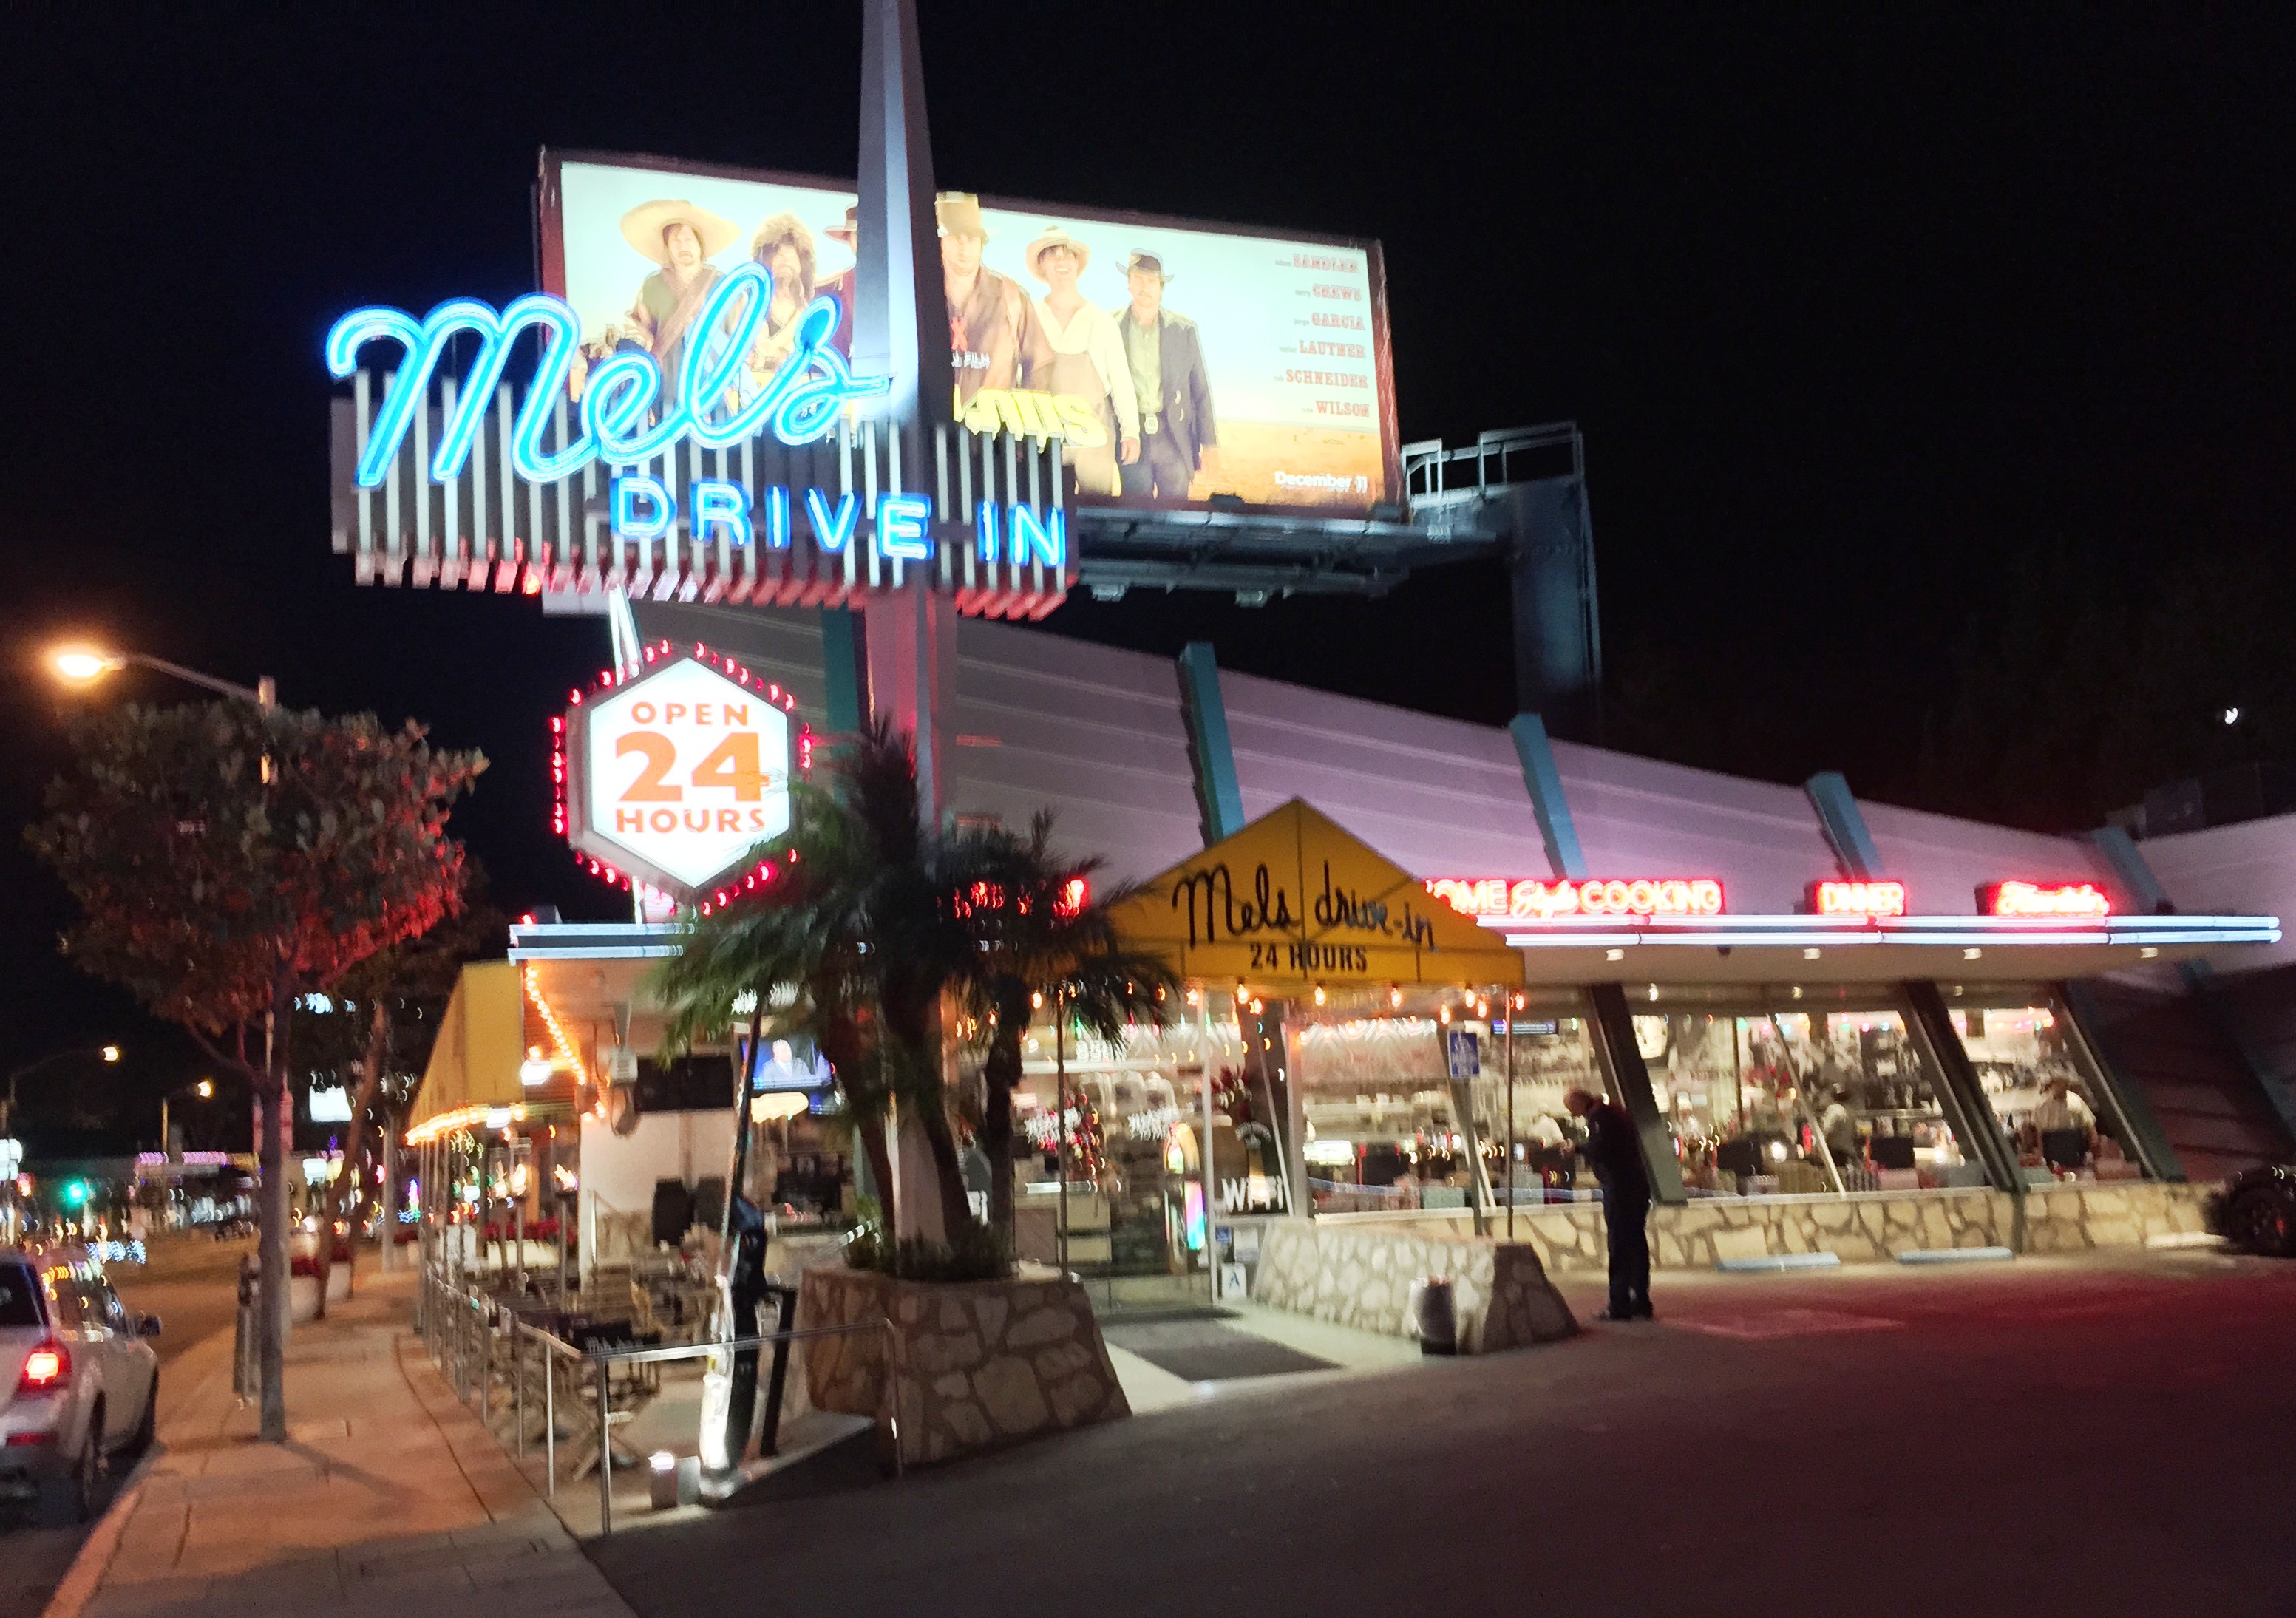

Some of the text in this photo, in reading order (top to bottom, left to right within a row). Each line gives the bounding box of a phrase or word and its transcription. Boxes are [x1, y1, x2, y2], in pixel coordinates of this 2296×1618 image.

[1292, 253, 1360, 274] SANDLER
[1312, 283, 1362, 302] CREWS
[1311, 312, 1365, 330] GARCIA
[1299, 339, 1367, 359] LAUTNER
[325, 260, 891, 488] Mels
[1286, 368, 1369, 389] SCHNEIDER
[1315, 400, 1370, 418] WILSON
[1274, 470, 1352, 492] December
[611, 475, 1069, 568] DRIVE IN
[631, 701, 750, 727] OPEN
[615, 730, 770, 803] 24
[615, 807, 767, 834] HOURS
[1172, 863, 1301, 951] Mels
[1426, 878, 1509, 915] OME
[1580, 880, 1723, 915] COOKING
[1249, 940, 1368, 973] 24 HOURS
